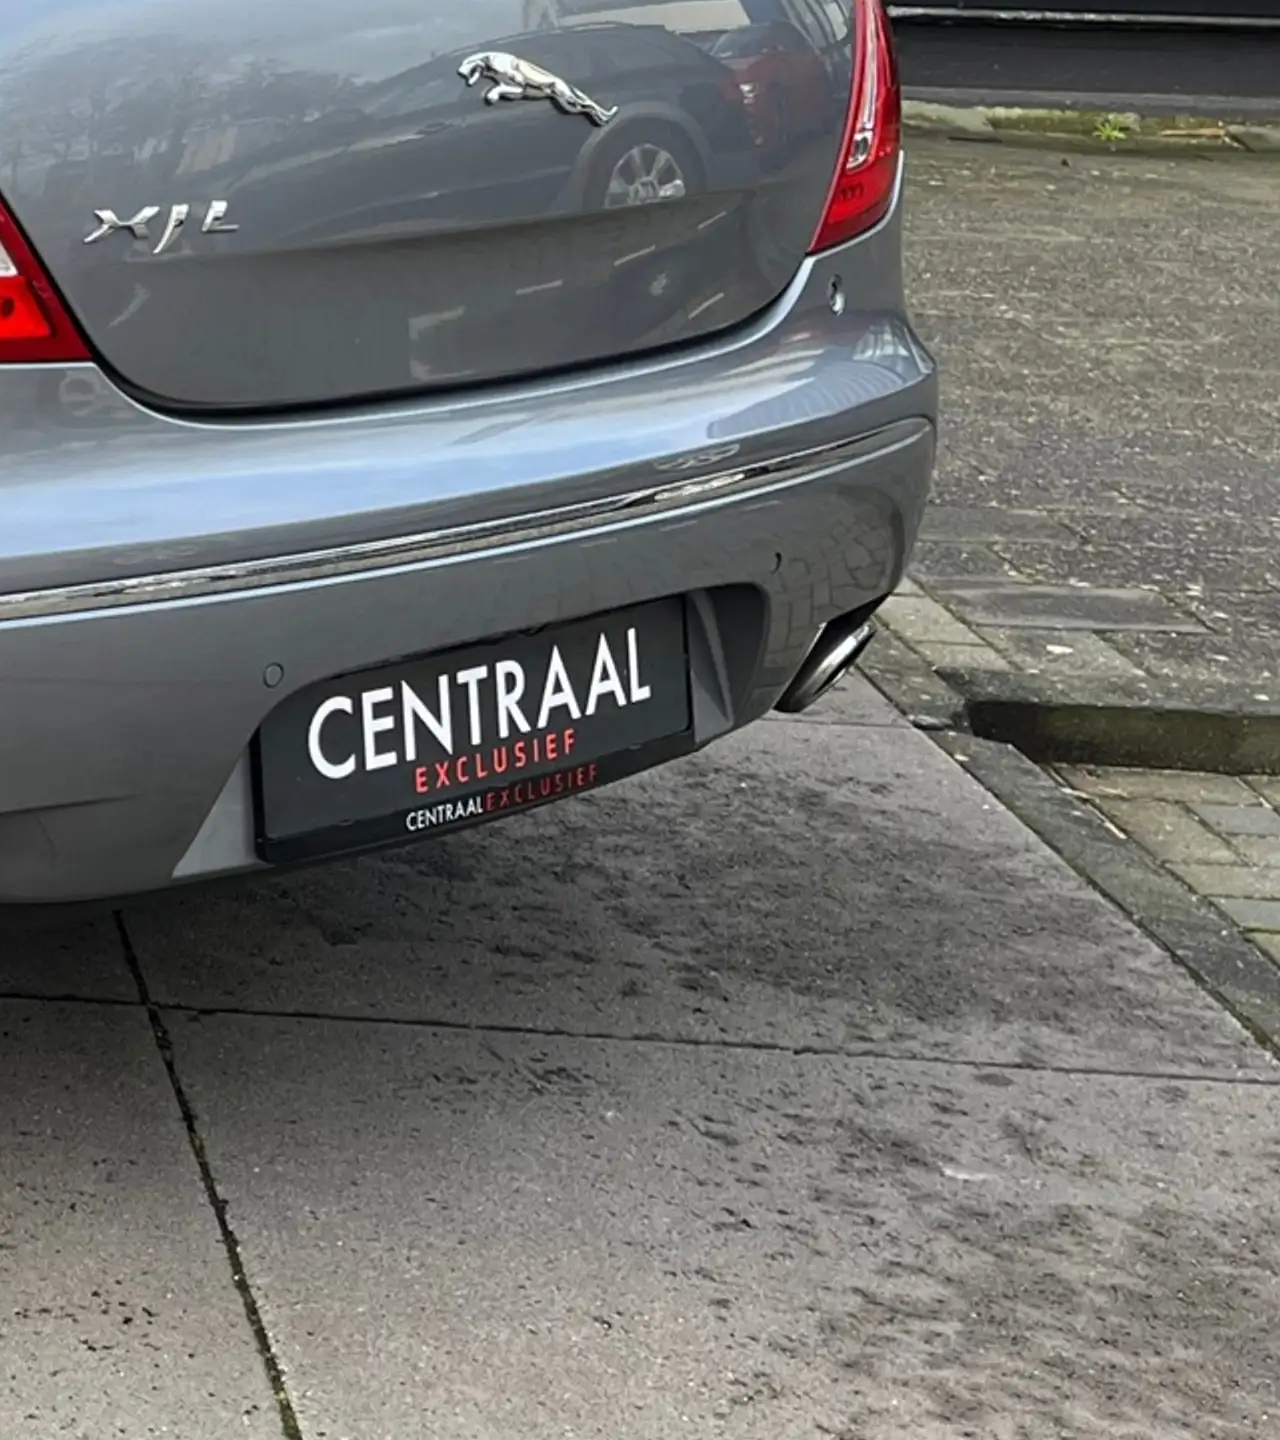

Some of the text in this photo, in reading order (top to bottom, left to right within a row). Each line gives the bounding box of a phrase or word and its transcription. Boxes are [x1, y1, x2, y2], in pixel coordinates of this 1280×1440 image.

[82, 199, 240, 255] XJL
[307, 627, 652, 780] CENTRAAL
[414, 727, 576, 793] EXCLUSIEF
